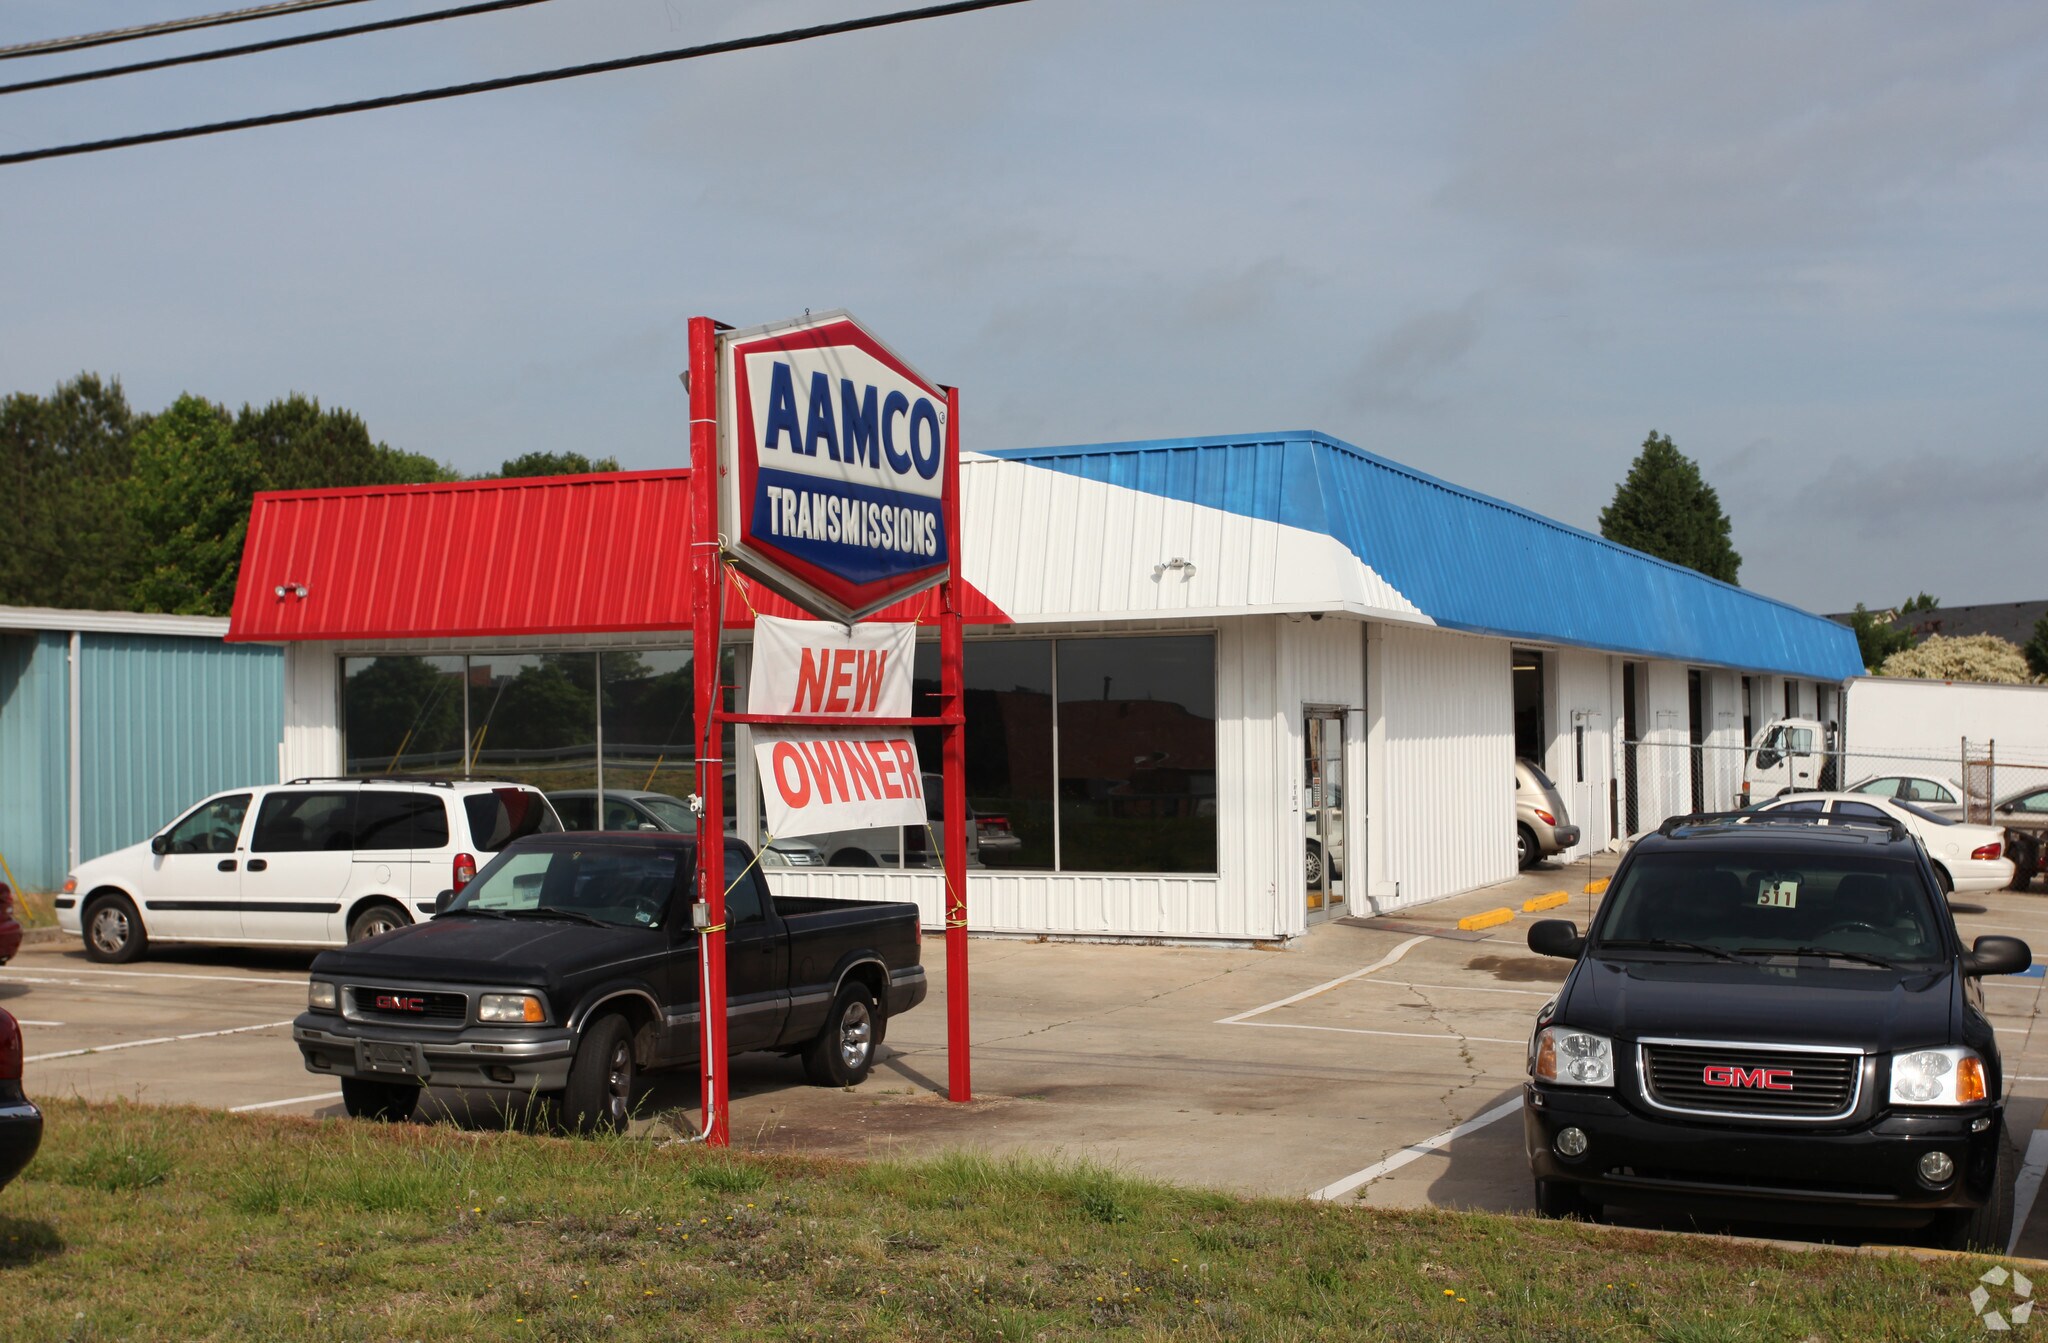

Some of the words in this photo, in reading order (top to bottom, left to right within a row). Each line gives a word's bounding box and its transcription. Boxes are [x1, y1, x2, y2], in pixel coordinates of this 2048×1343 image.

[765, 361, 941, 480] AAMCO
[767, 485, 937, 557] TRANSMISSIONS
[792, 647, 888, 713] NEW
[772, 738, 921, 809] OWNER
[1760, 889, 1791, 907] 511
[375, 995, 424, 1011] GMC
[1703, 1065, 1793, 1090] GMC
